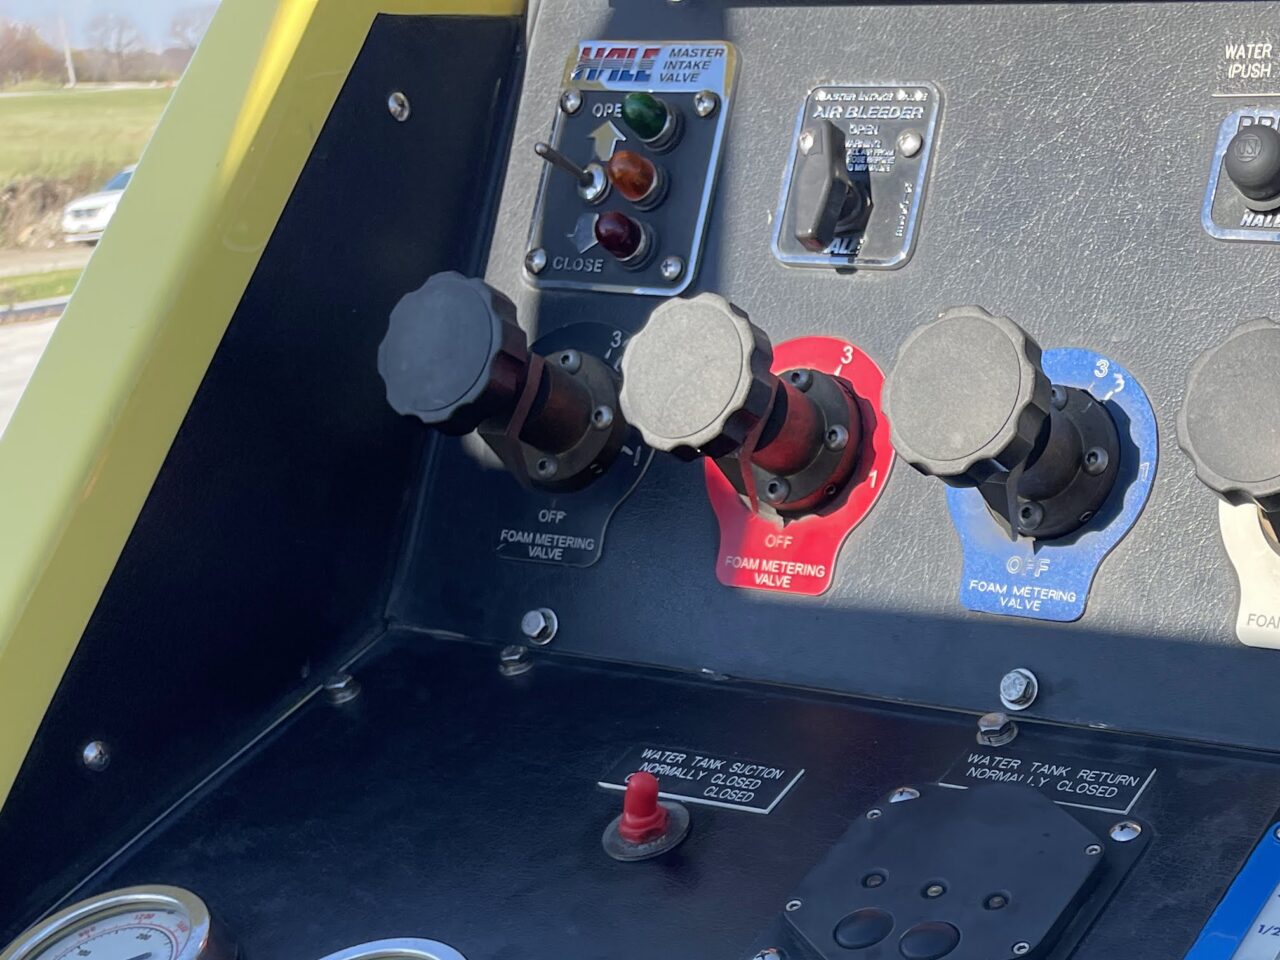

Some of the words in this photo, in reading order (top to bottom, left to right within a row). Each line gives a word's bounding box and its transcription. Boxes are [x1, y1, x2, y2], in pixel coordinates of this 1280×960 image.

[669, 48, 724, 58] MASTER
[1225, 43, 1273, 60] WATER
[571, 47, 661, 81] HALE
[663, 61, 711, 70] INTAKE
[1228, 63, 1272, 79] (PUSH
[659, 72, 700, 83] VALVE
[592, 103, 624, 118] OPE
[812, 105, 844, 119] AIR
[844, 105, 924, 120] BLEEDER
[849, 123, 880, 135] OPEN
[552, 255, 604, 273] CLOSE
[610, 330, 622, 348] 3
[840, 345, 854, 364] 3
[1093, 359, 1110, 378] 3
[868, 470, 878, 489] 1
[1138, 462, 1150, 482] 1
[538, 509, 567, 524] OFF
[500, 528, 535, 545] FOAM
[536, 532, 595, 551] METERING
[764, 534, 793, 549] OFF
[528, 545, 563, 561] VALVE
[724, 555, 760, 572] FOAM
[760, 560, 826, 578] METERING
[1006, 555, 1051, 578] OFF
[753, 573, 792, 589] VALVE
[969, 580, 1008, 595] FOAM
[1013, 585, 1077, 602] METERING
[1000, 596, 1042, 612] VALVE
[640, 748, 687, 764] WATER
[691, 755, 727, 770] TANK
[729, 762, 785, 780] SUCTION
[967, 753, 1021, 769] WATER
[1030, 761, 1071, 777] TANK
[1076, 769, 1140, 787] RETURN
[637, 761, 708, 781] NORMALLY
[710, 773, 762, 790] CLOSED
[703, 785, 755, 803] CLOSED
[1056, 780, 1119, 798] CLOSED
